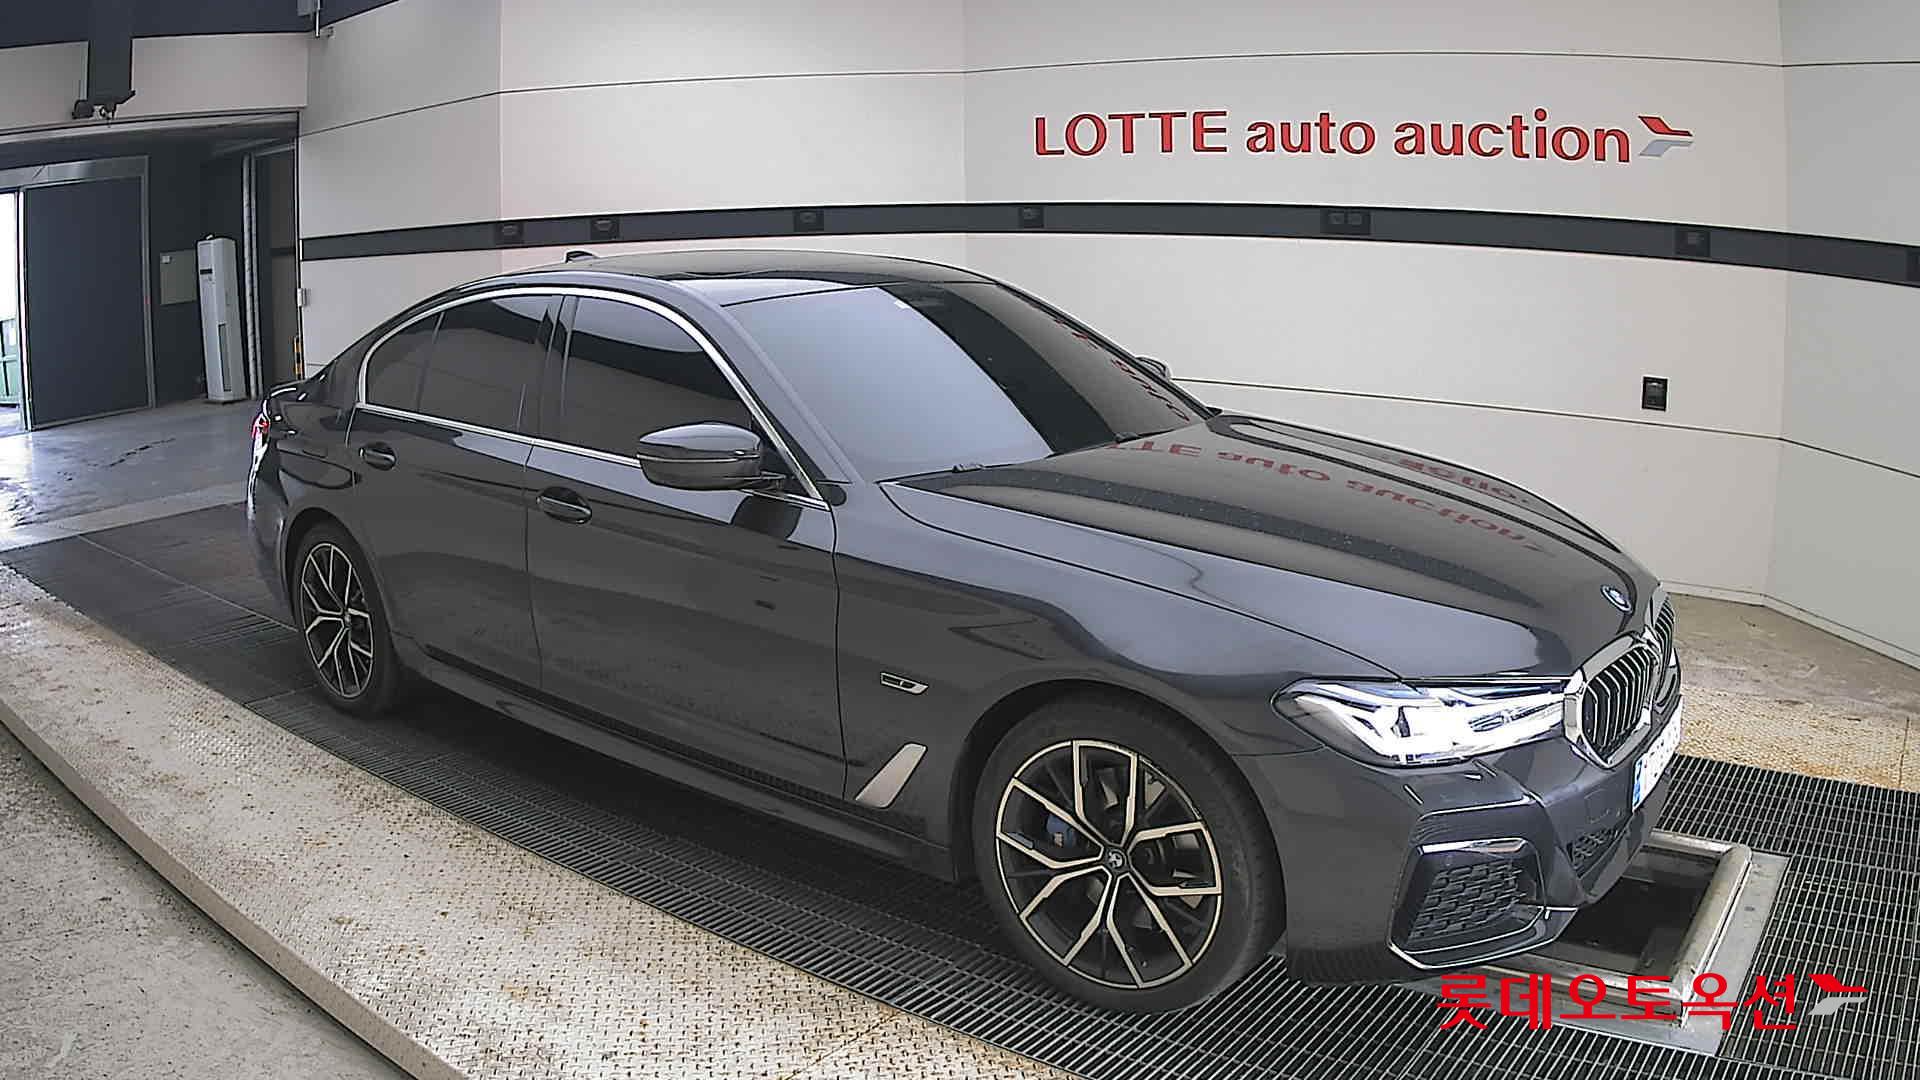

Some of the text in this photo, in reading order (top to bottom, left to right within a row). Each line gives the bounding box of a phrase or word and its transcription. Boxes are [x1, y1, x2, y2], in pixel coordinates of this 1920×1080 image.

[1034, 108, 1632, 164] LOTTE auto auction
